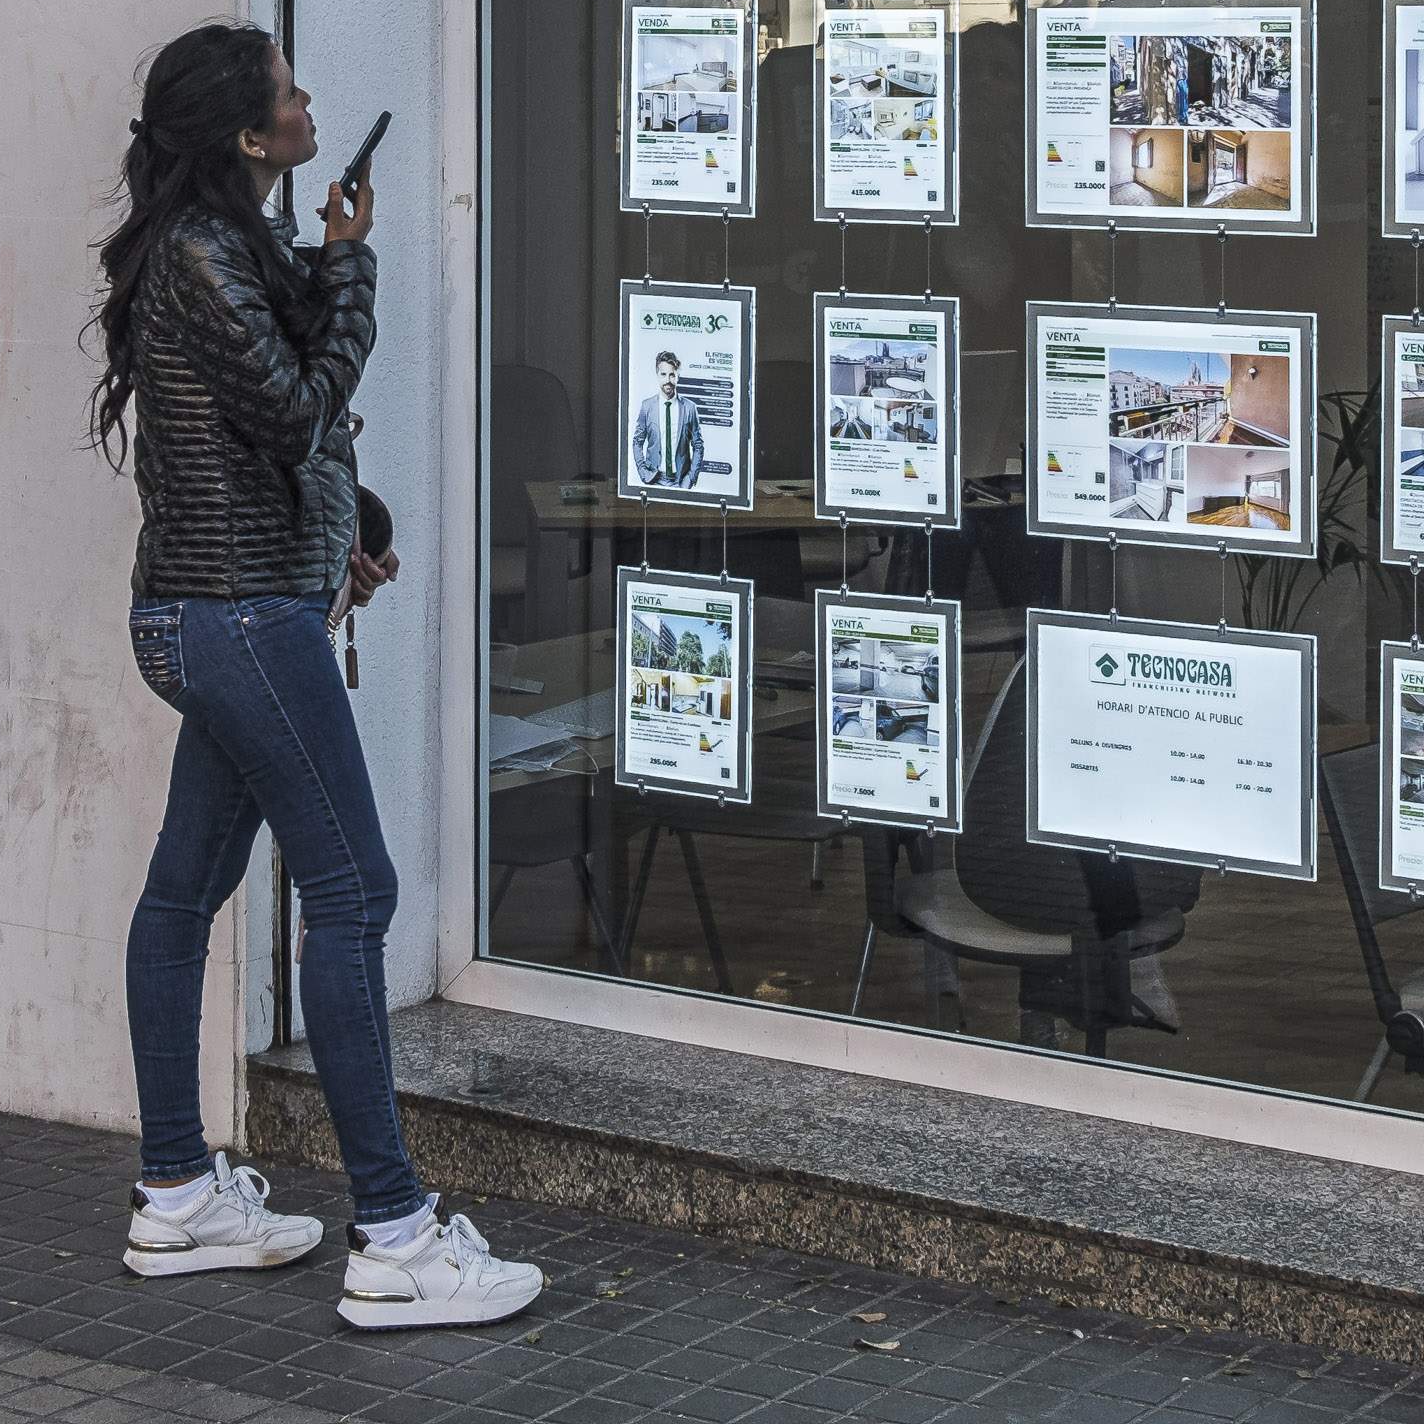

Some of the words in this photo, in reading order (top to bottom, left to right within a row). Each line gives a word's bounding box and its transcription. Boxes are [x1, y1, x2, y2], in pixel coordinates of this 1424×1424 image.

[638, 18, 669, 28] VENDA
[829, 22, 862, 32] VENTA
[1046, 22, 1081, 32] VENTA
[830, 321, 862, 331] VENTA
[1046, 332, 1081, 343] VENTA
[632, 595, 662, 606] VENTA
[831, 619, 864, 630] VENTA
[1127, 653, 1232, 687] TECNOCASA
[1132, 682, 1190, 693] FRANCHISING
[1196, 689, 1237, 698] NETWORK
[1097, 700, 1133, 713] HORARI
[1138, 704, 1190, 720] D'ATENCIO
[1195, 712, 1207, 722] AL
[1210, 713, 1244, 726] PUBLIC
